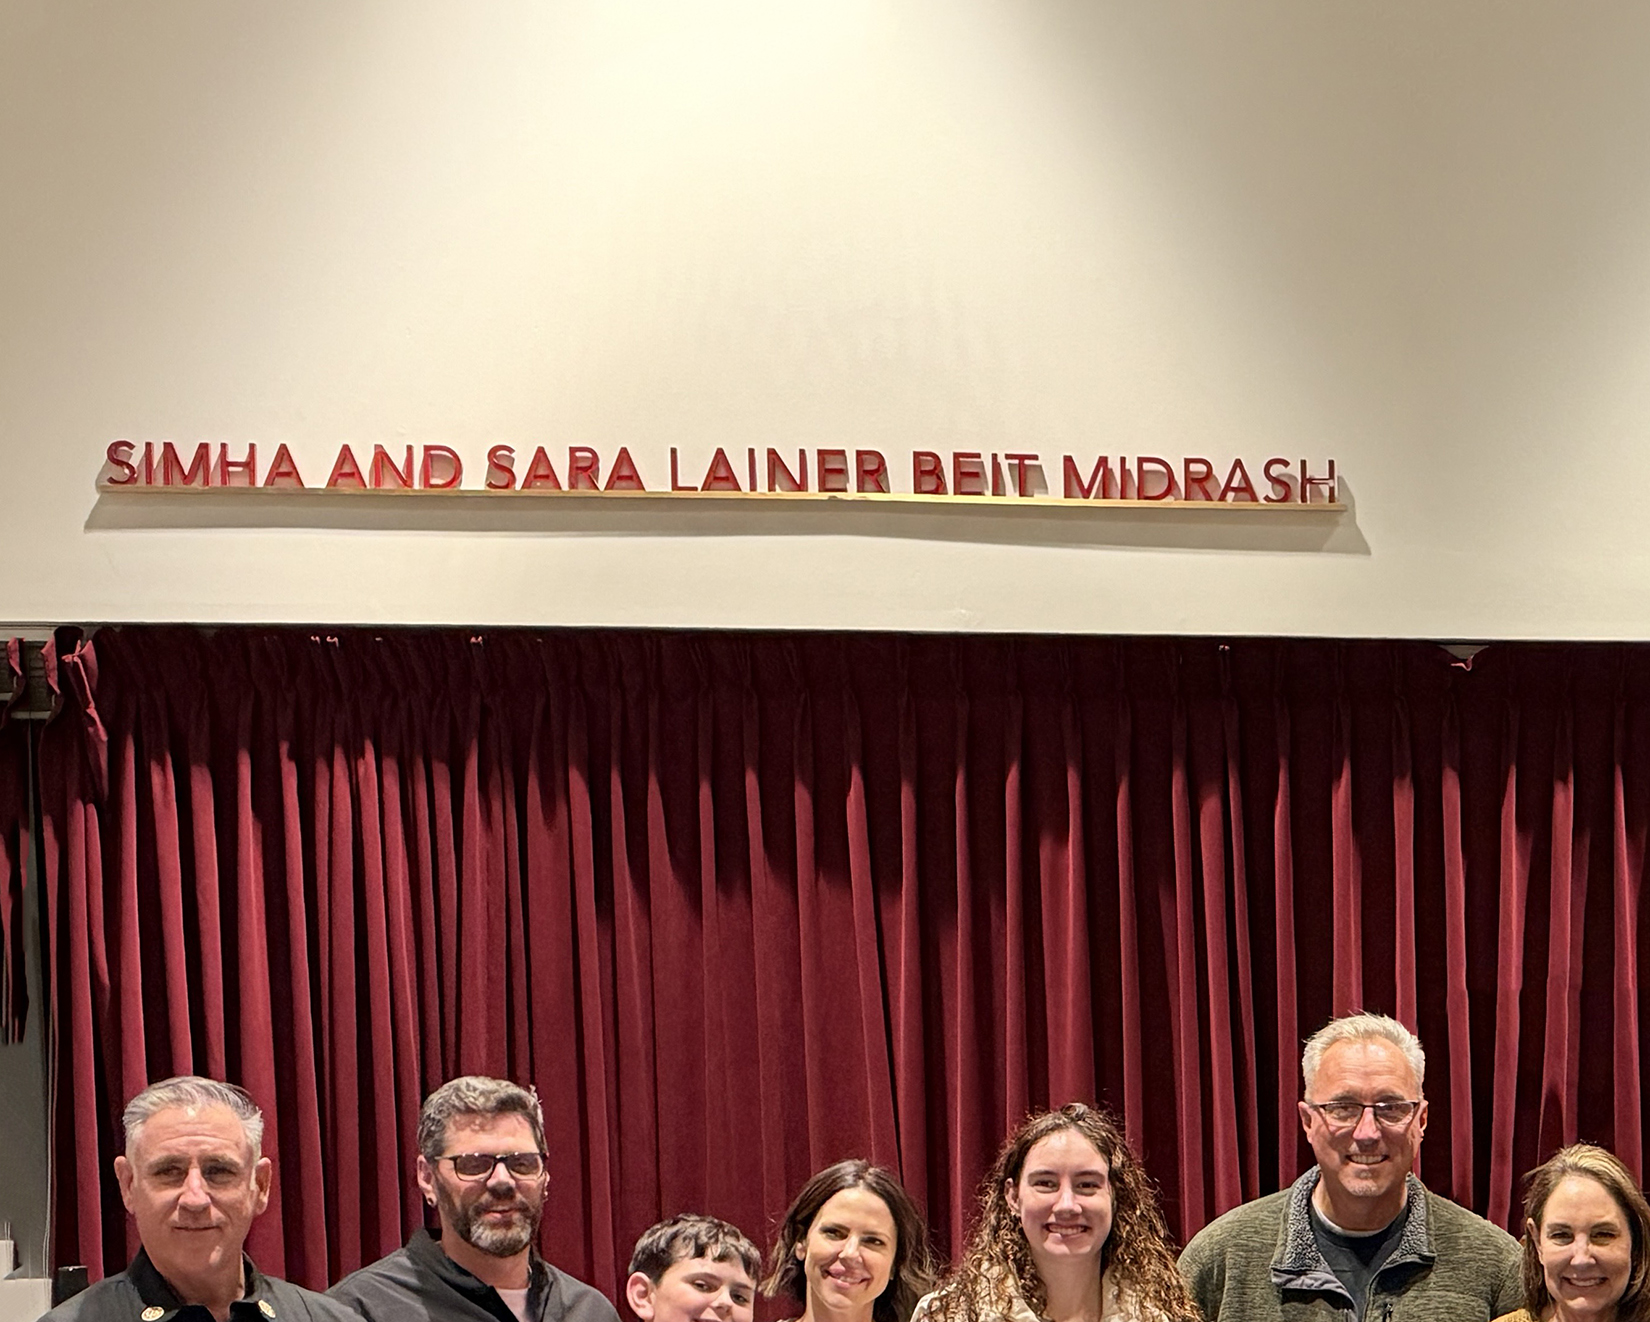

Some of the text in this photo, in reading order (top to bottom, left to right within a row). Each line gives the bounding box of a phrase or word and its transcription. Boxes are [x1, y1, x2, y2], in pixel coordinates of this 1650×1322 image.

[106, 440, 1337, 504] SIMHA AND SARA LAINER BEIT MIDRASH
